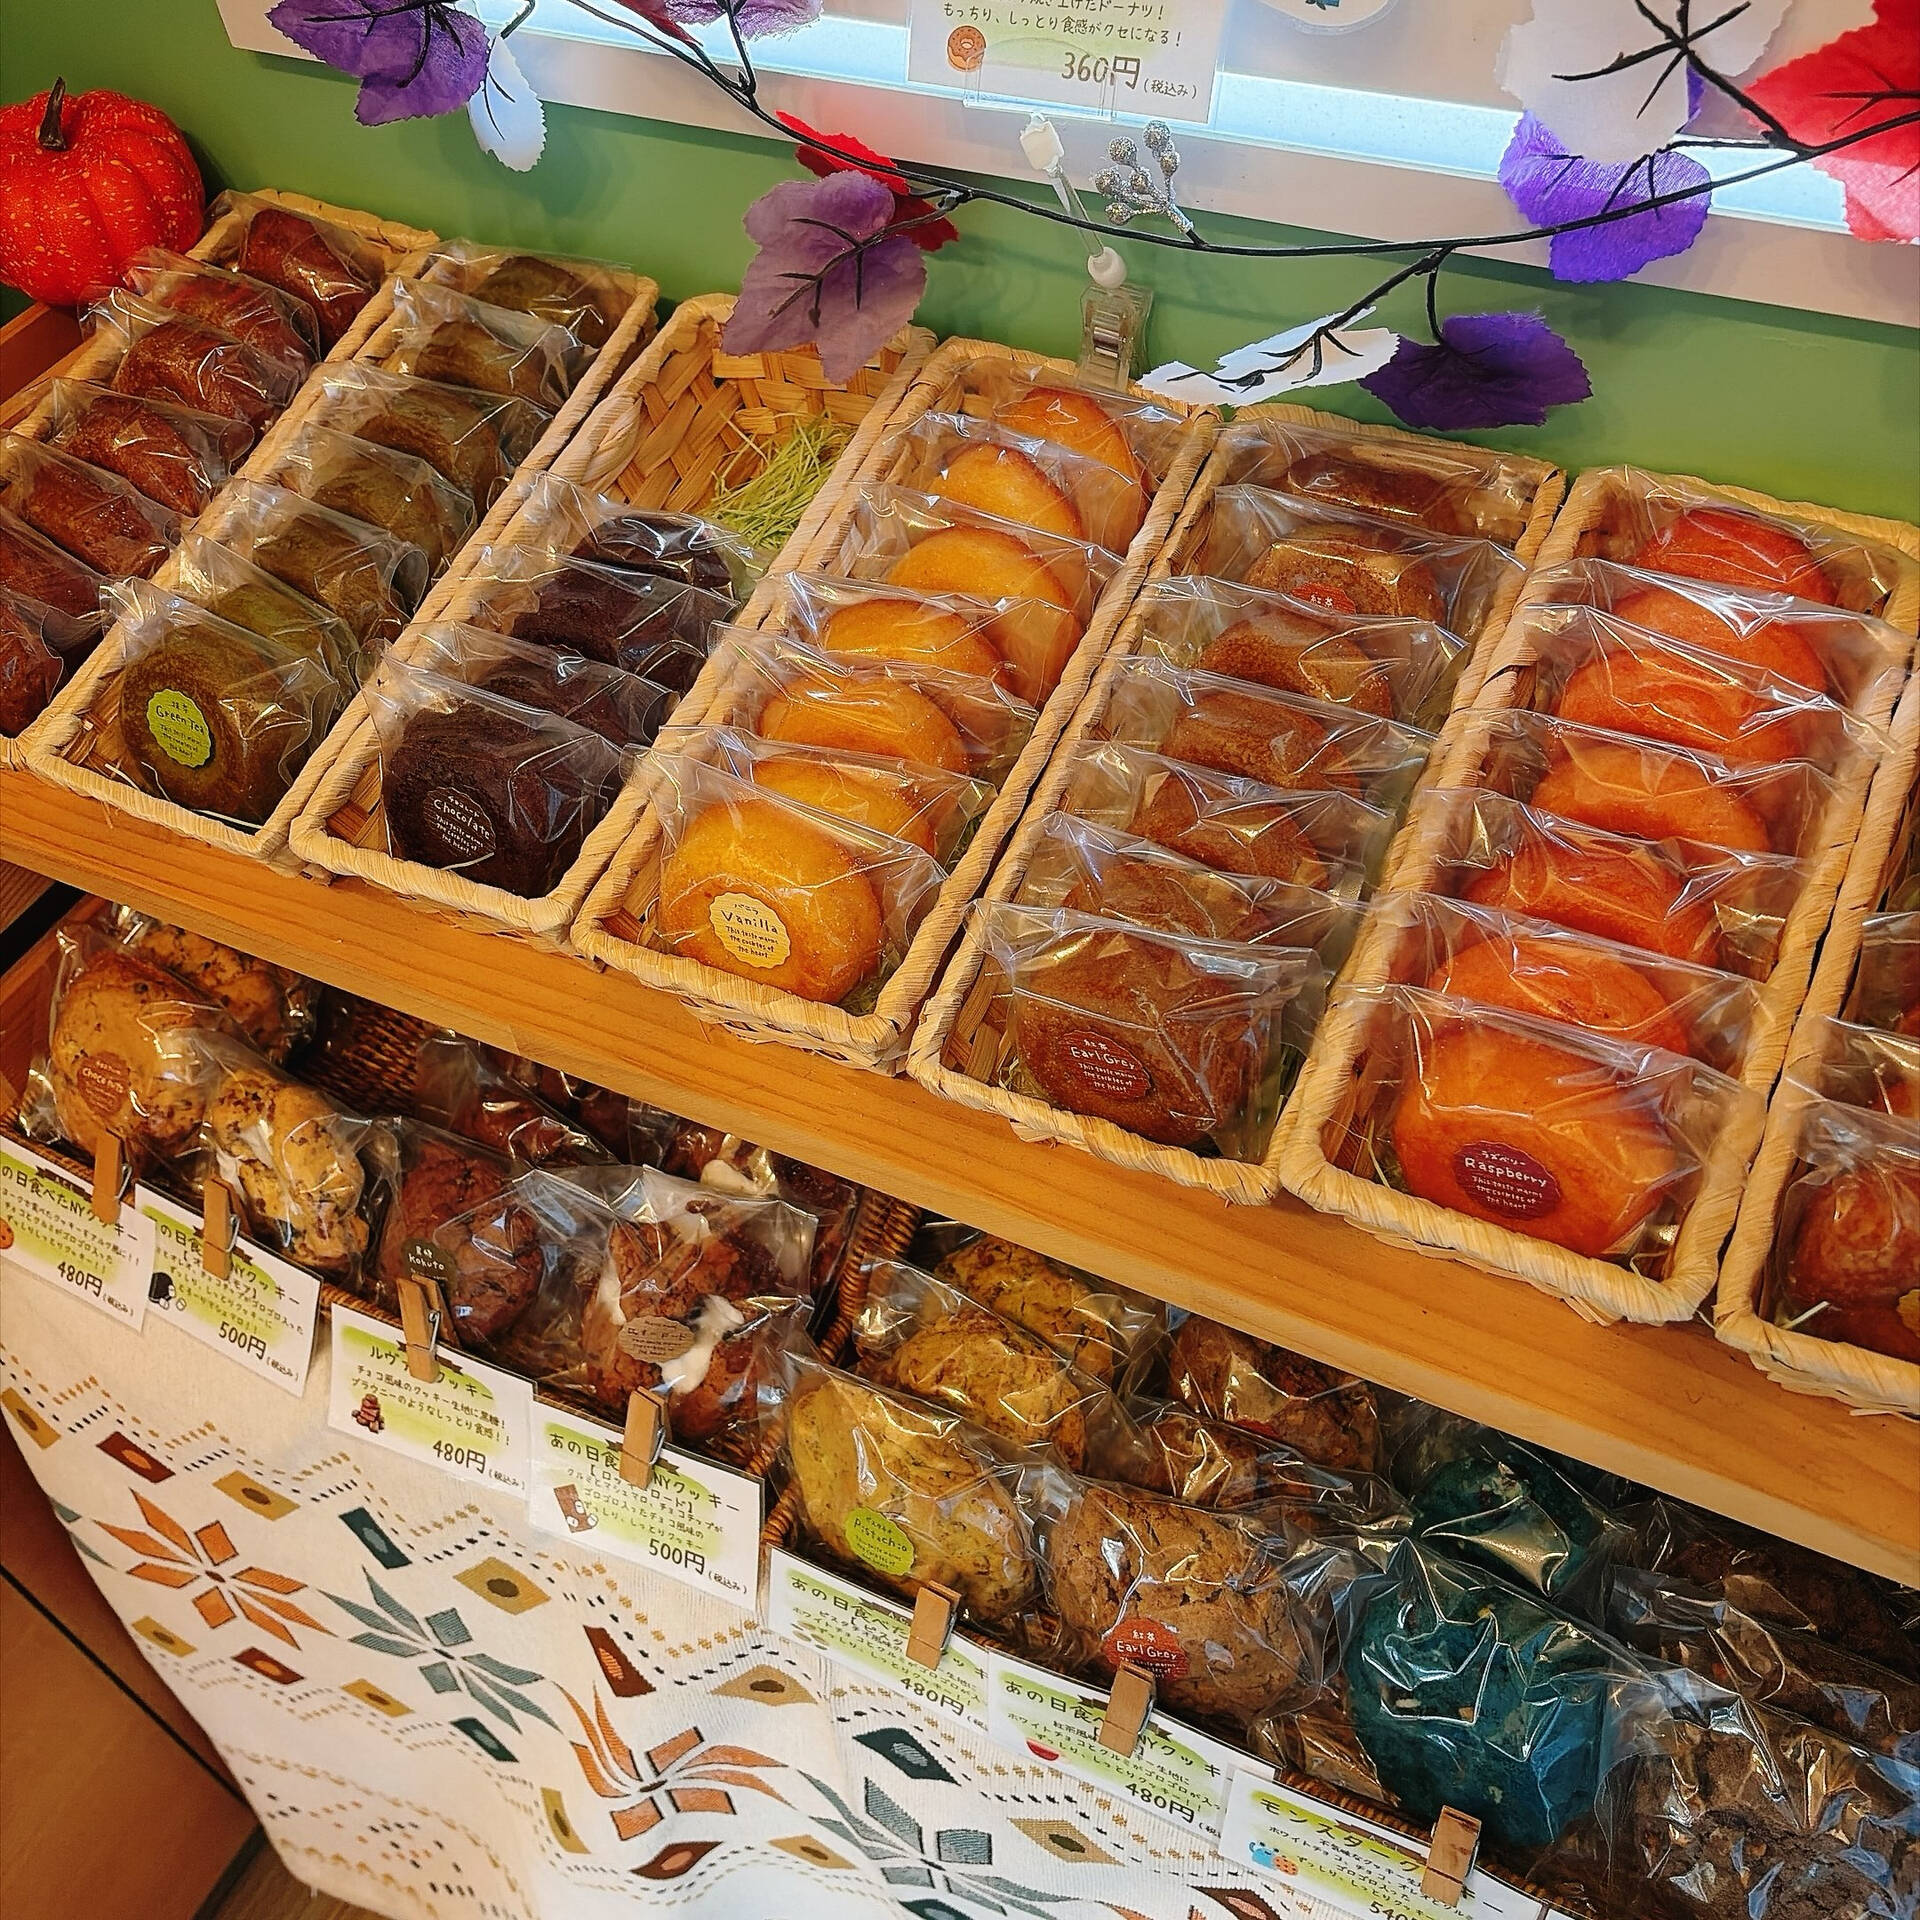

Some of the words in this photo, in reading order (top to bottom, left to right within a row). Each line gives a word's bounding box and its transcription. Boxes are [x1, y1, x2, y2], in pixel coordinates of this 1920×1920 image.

[943, 3, 1182, 47] もっちり、しっとり食感がクセになる！
[1061, 51, 1141, 90] 360円
[1310, 594, 1333, 607] 紅茶
[156, 705, 187, 725] Green
[188, 717, 205, 735] Tea
[434, 799, 490, 840] Chocolate
[721, 910, 778, 934] Vanilla
[1071, 1046, 1101, 1060] Earl
[1103, 1053, 1135, 1070] Grey
[1465, 1157, 1546, 1187] Raspberry
[58, 1261, 103, 1297] 480円
[218, 1321, 267, 1360] 500円
[433, 1440, 486, 1474] 480円
[549, 1433, 740, 1512] あの日食NYクッキー
[853, 1517, 907, 1552] Pistachio
[649, 1538, 705, 1575] 500円
[1116, 1640, 1144, 1655] Earl
[1147, 1646, 1177, 1660] Grey
[1132, 1629, 1156, 1642] 紅茶
[900, 1677, 964, 1716] 480円
[1125, 1783, 1195, 1823] 480円
[1261, 1798, 1503, 1913] モンスタークキー
